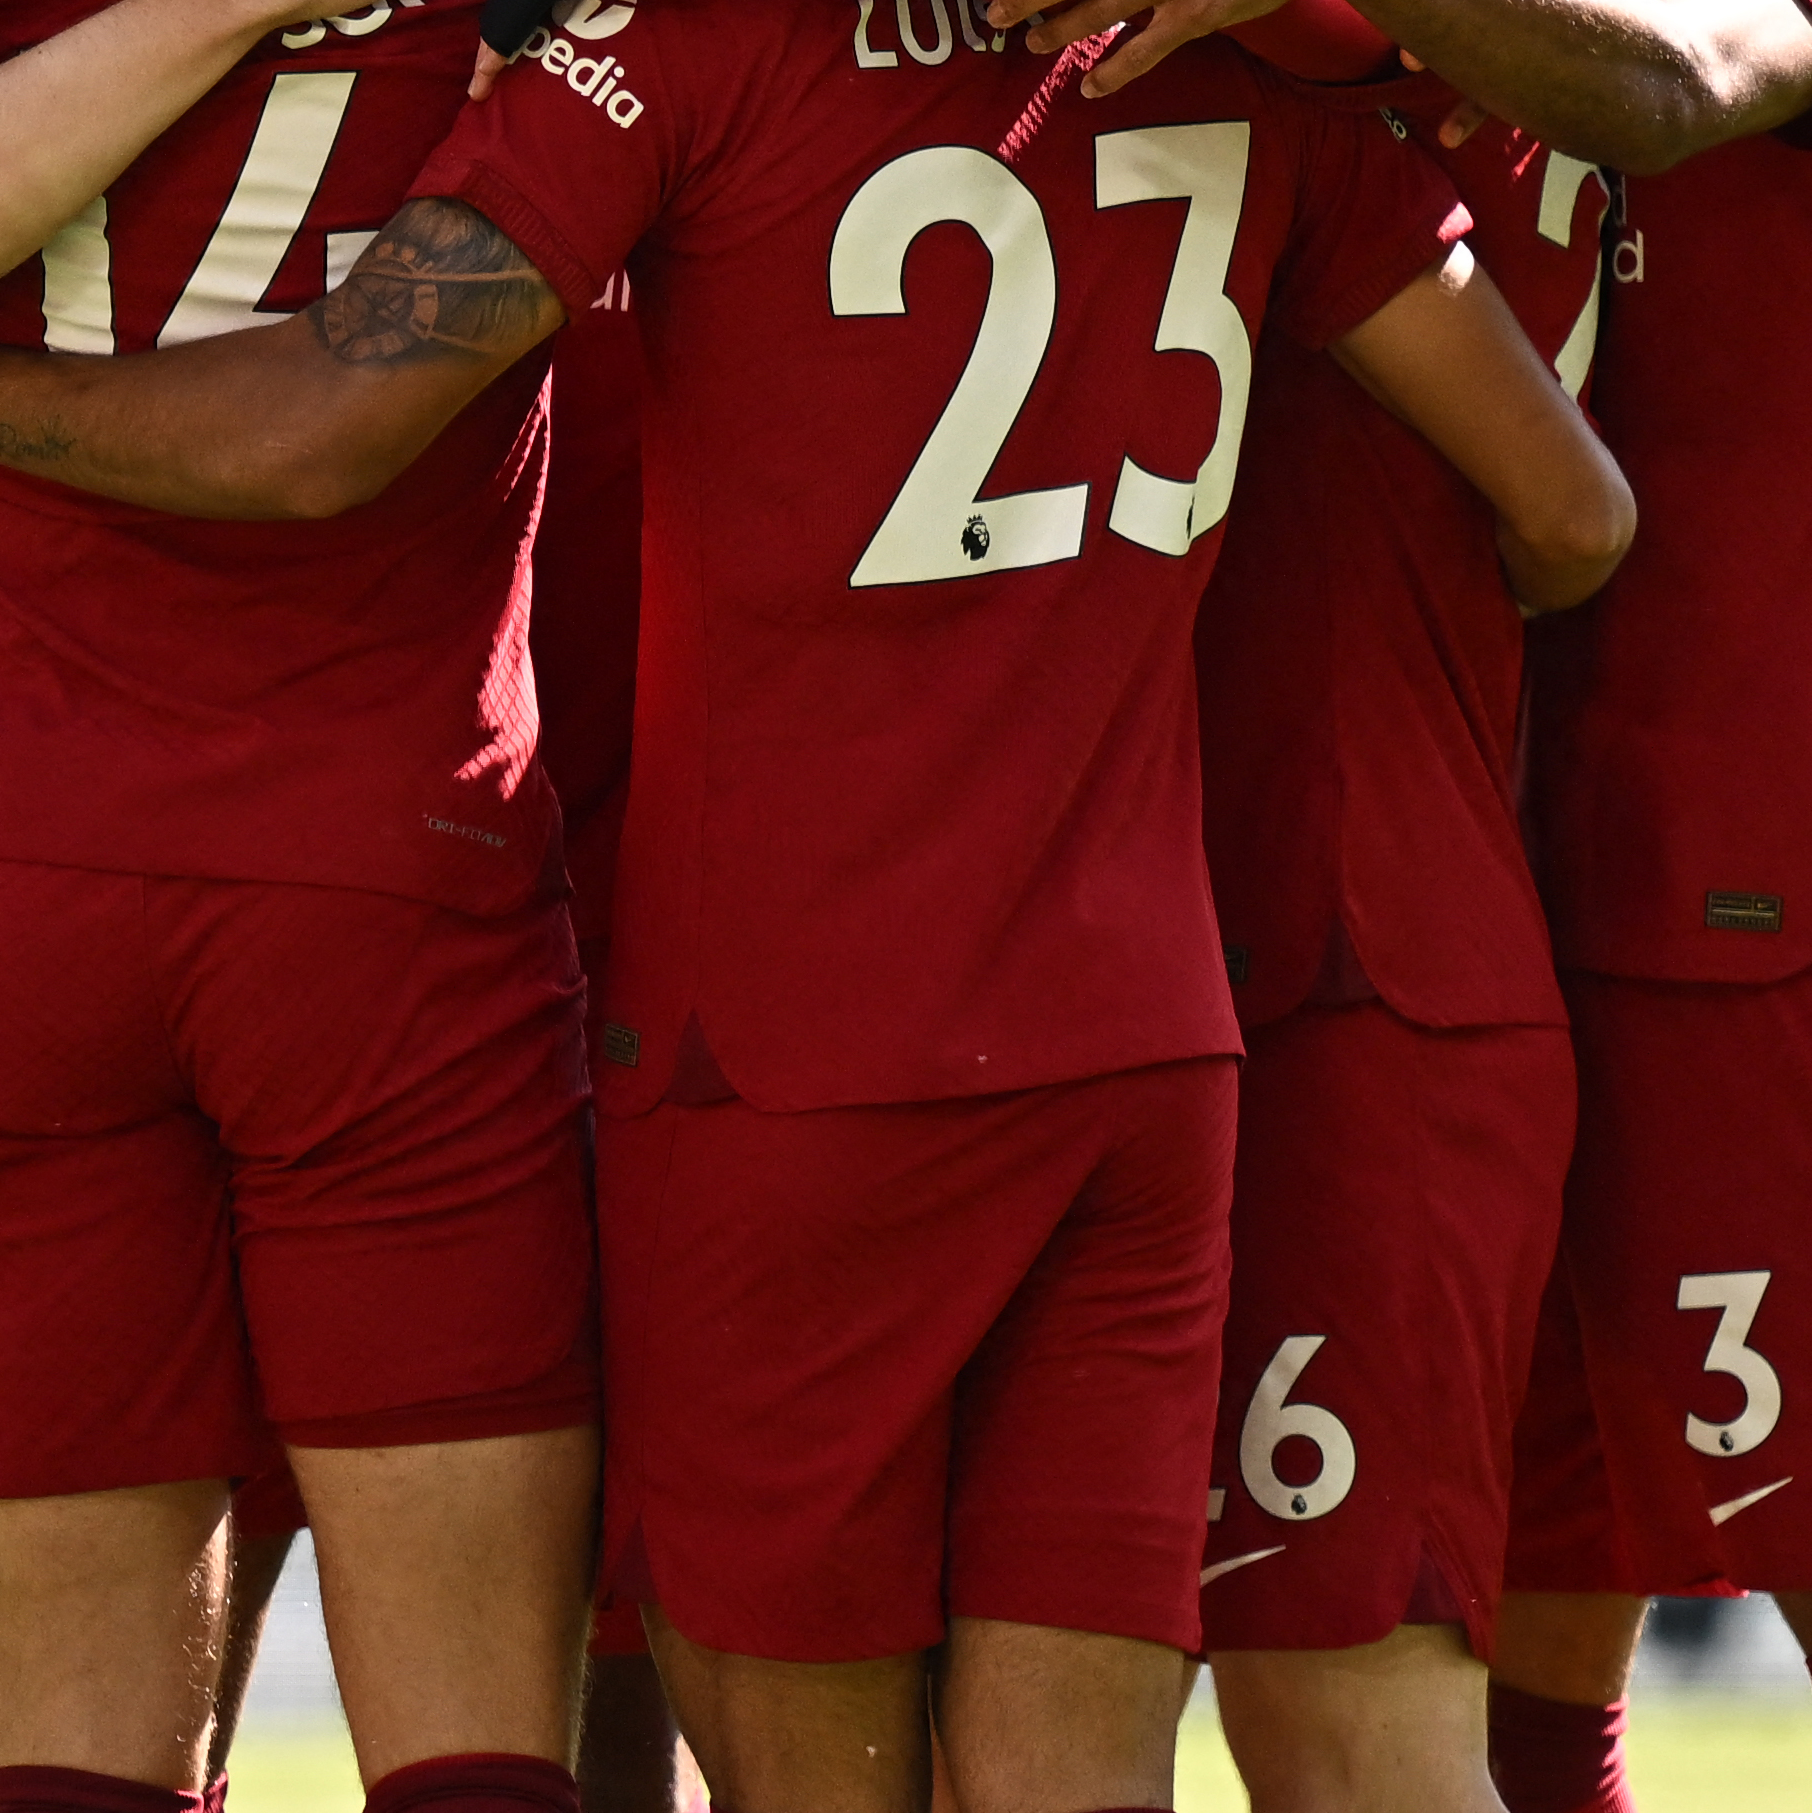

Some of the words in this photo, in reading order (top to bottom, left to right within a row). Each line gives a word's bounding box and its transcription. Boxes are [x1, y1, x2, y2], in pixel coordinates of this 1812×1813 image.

[506, 26, 645, 129] pedia
[828, 120, 1253, 589] 23
[1206, 1334, 1357, 1521] 6
[1676, 1269, 1782, 1458] 3
